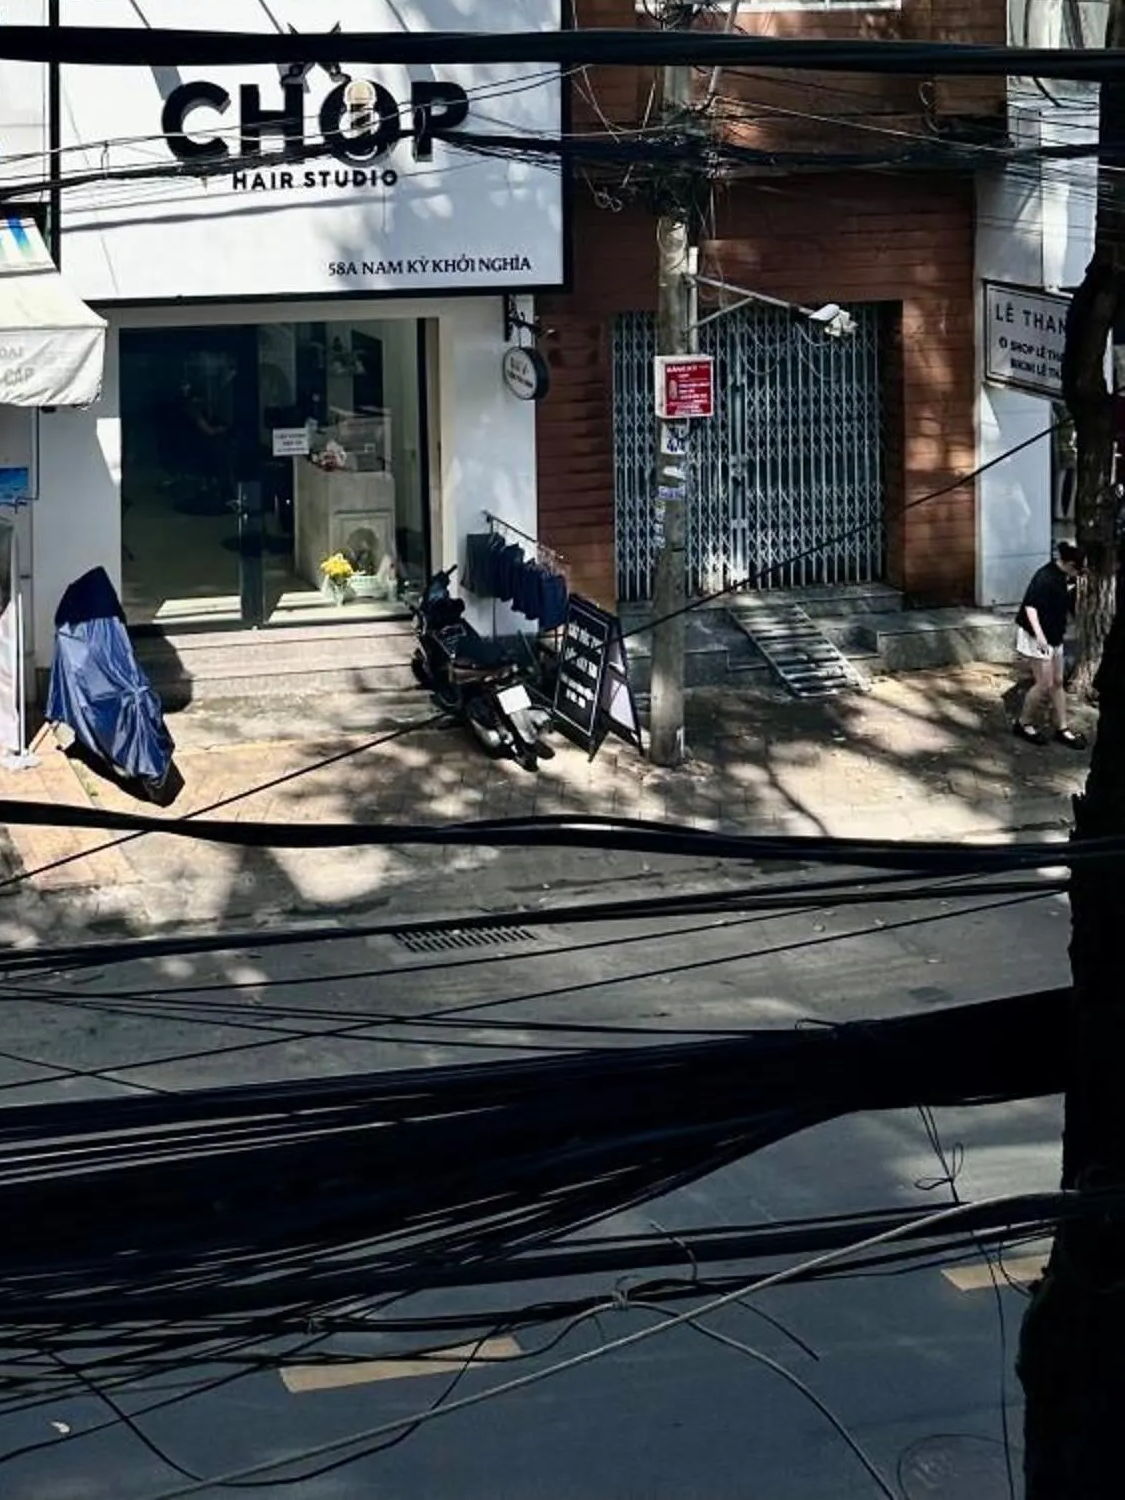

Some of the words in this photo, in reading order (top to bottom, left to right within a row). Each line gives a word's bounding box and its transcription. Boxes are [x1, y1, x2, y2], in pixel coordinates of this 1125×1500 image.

[162, 80, 470, 168] CHOP
[232, 171, 294, 190] HAIR
[303, 169, 399, 188] STUDIO
[328, 260, 358, 277] 58A
[362, 259, 404, 276] NAM
[996, 302, 1014, 324] LÊ
